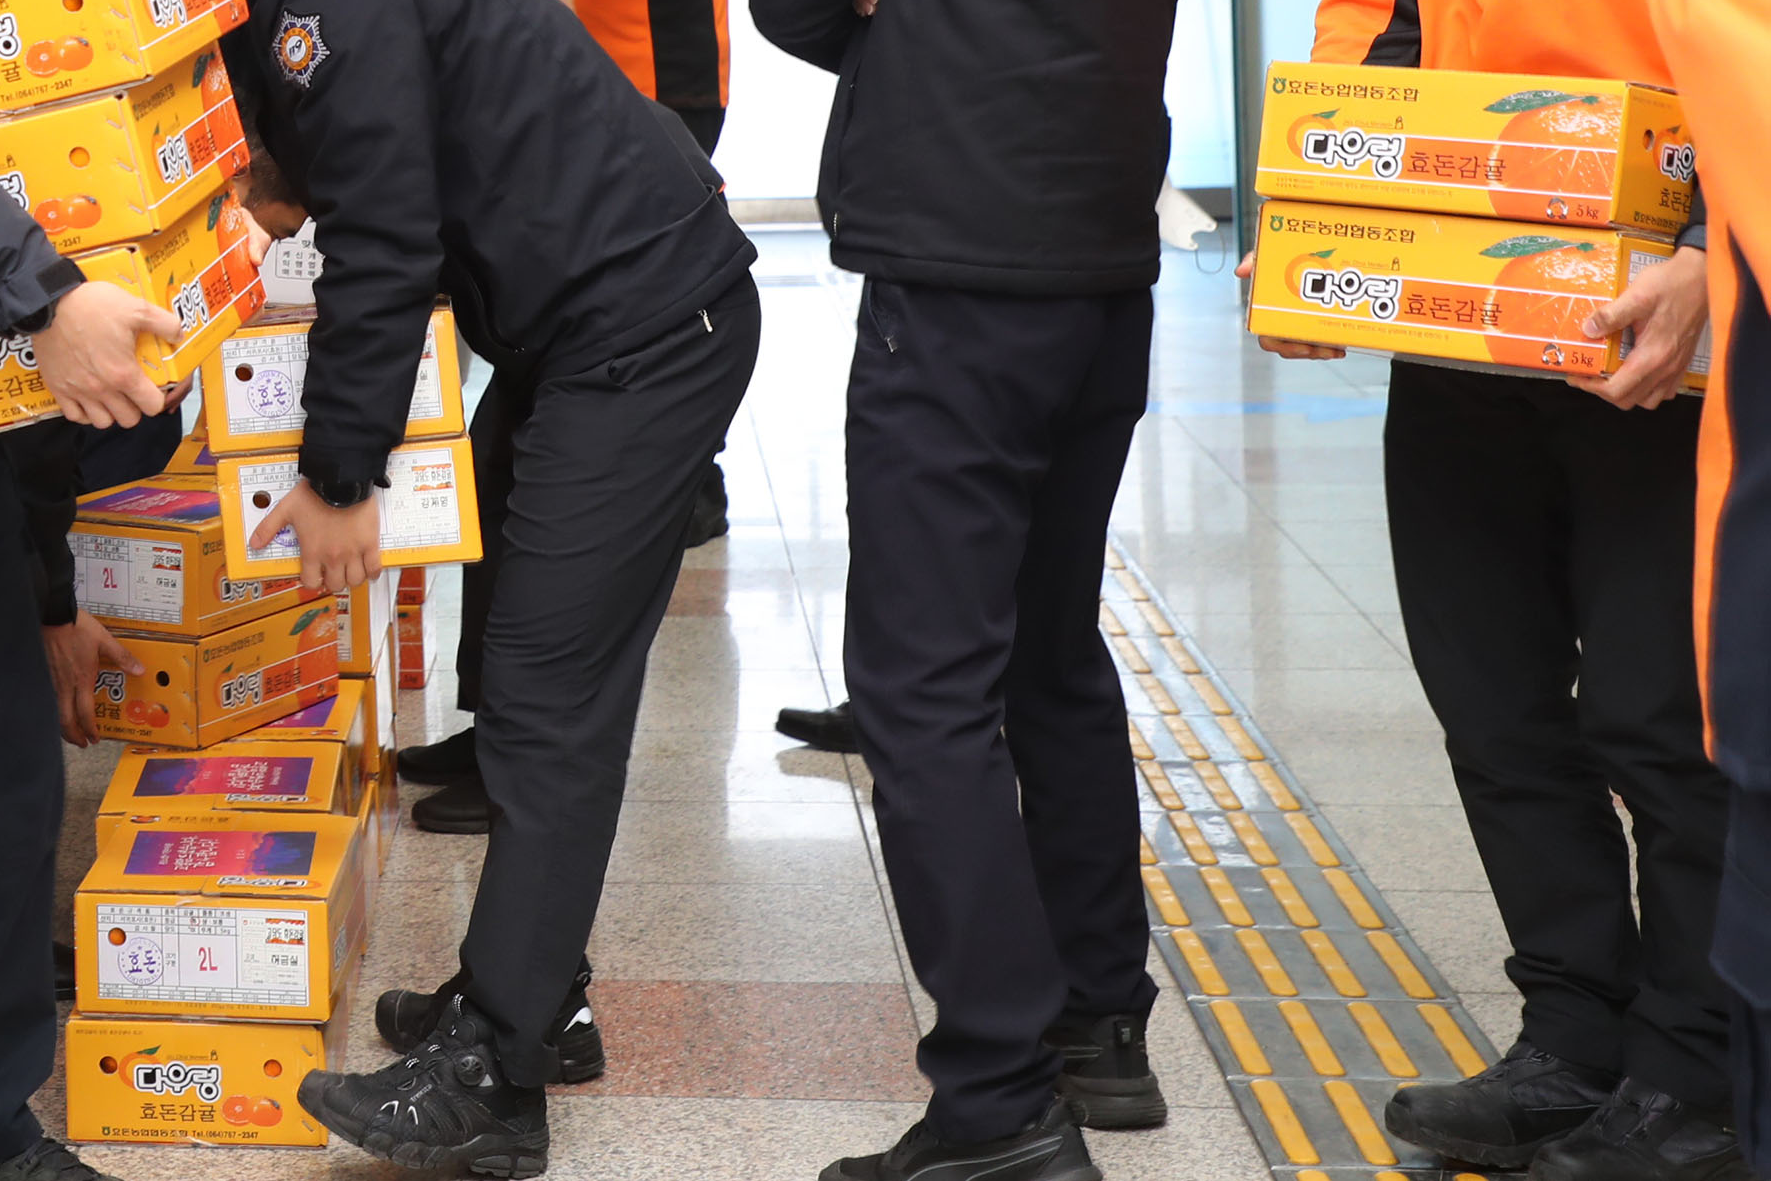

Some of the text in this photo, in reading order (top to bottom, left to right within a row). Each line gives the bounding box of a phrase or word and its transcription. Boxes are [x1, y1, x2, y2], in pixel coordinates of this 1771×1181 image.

[1287, 79, 1420, 103] 효돈농업협동조합
[1303, 128, 1508, 182] 다우렁 효돈감귤
[1285, 217, 1416, 244] 효돈농업협동조합
[1301, 269, 1503, 327] 다우렁 효돈감귤
[102, 567, 118, 590] 2L
[198, 946, 218, 972] 2L
[133, 1059, 223, 1102] 다우렁
[139, 1102, 217, 1123] 효돈감귤
